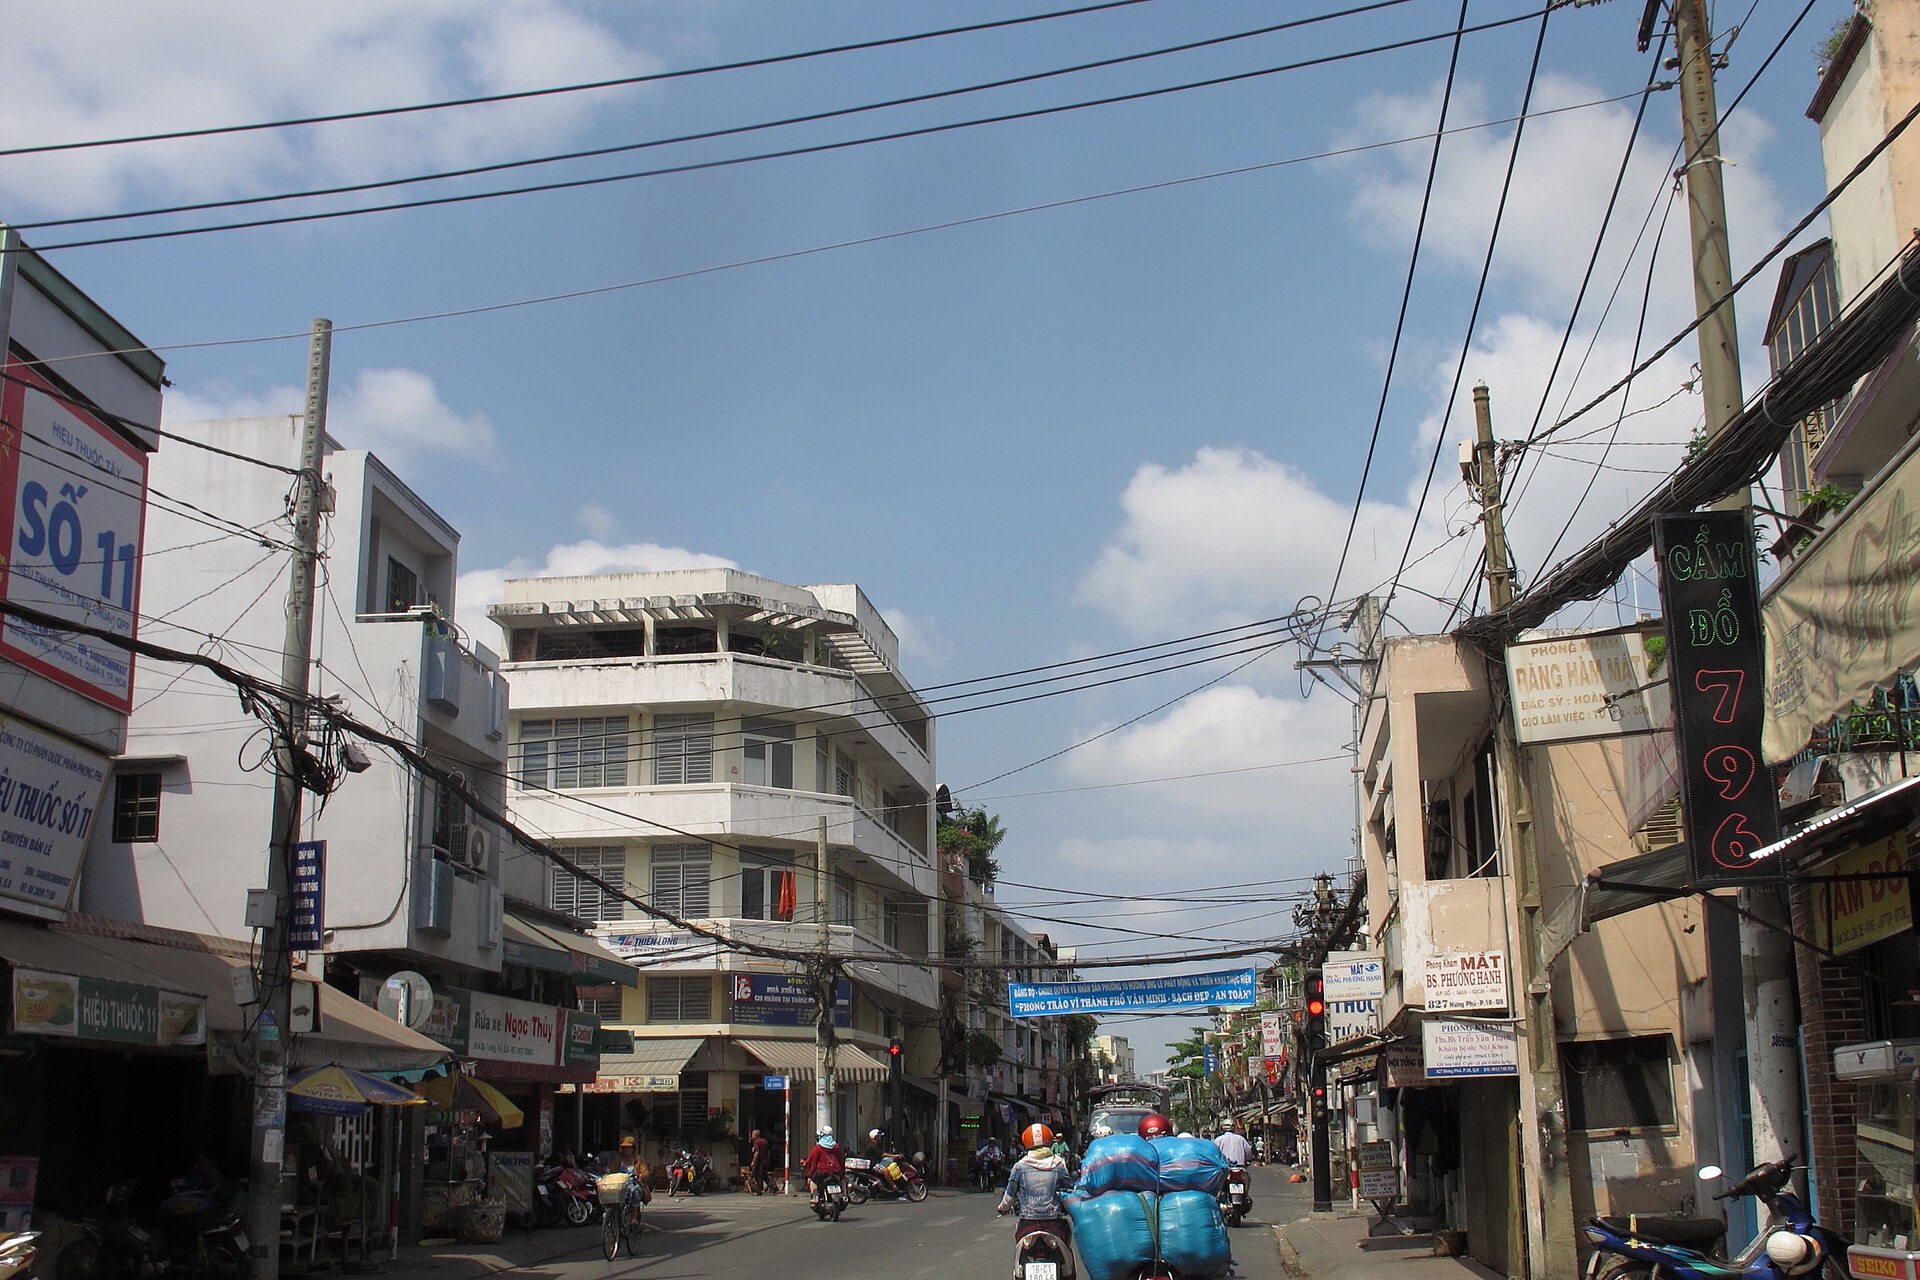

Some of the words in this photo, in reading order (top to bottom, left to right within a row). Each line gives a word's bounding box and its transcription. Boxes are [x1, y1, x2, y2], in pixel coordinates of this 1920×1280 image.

[52, 421, 73, 447] HIỆU
[75, 437, 104, 468] THUỐC
[19, 481, 89, 576] SỐ
[97, 530, 136, 610] 11
[1531, 643, 1577, 658] PHÒNG
[1515, 663, 1563, 694] RĂNG
[1566, 655, 1603, 688] HÀM
[1541, 714, 1562, 726] LÀM
[1563, 711, 1586, 724] VIỆC
[14, 780, 62, 829] THUỐC
[59, 790, 87, 835] SỐ
[77, 807, 94, 840] 11
[658, 937, 679, 946] LONG
[1460, 952, 1502, 970] MẮT
[1441, 971, 1477, 988] PHƯƠNG
[1079, 995, 1109, 1008] THÀNH
[1109, 991, 1126, 1006] PHỐ
[1126, 992, 1146, 1005] VĂN
[1145, 993, 1167, 1004] MINH
[1171, 991, 1193, 1004] SẠCH
[1215, 990, 1227, 1000] AN
[1427, 1000, 1448, 1009] 827
[82, 990, 109, 1033] HIỆU
[110, 992, 145, 1032] THUỐC
[147, 1006, 158, 1034] 11
[474, 1009, 490, 1030] Rửa
[491, 1018, 501, 1032] xe
[504, 1011, 528, 1041] Ngọc
[1441, 1021, 1473, 1033] PHÒNG
[1856, 1256, 1897, 1276] SEIKO
